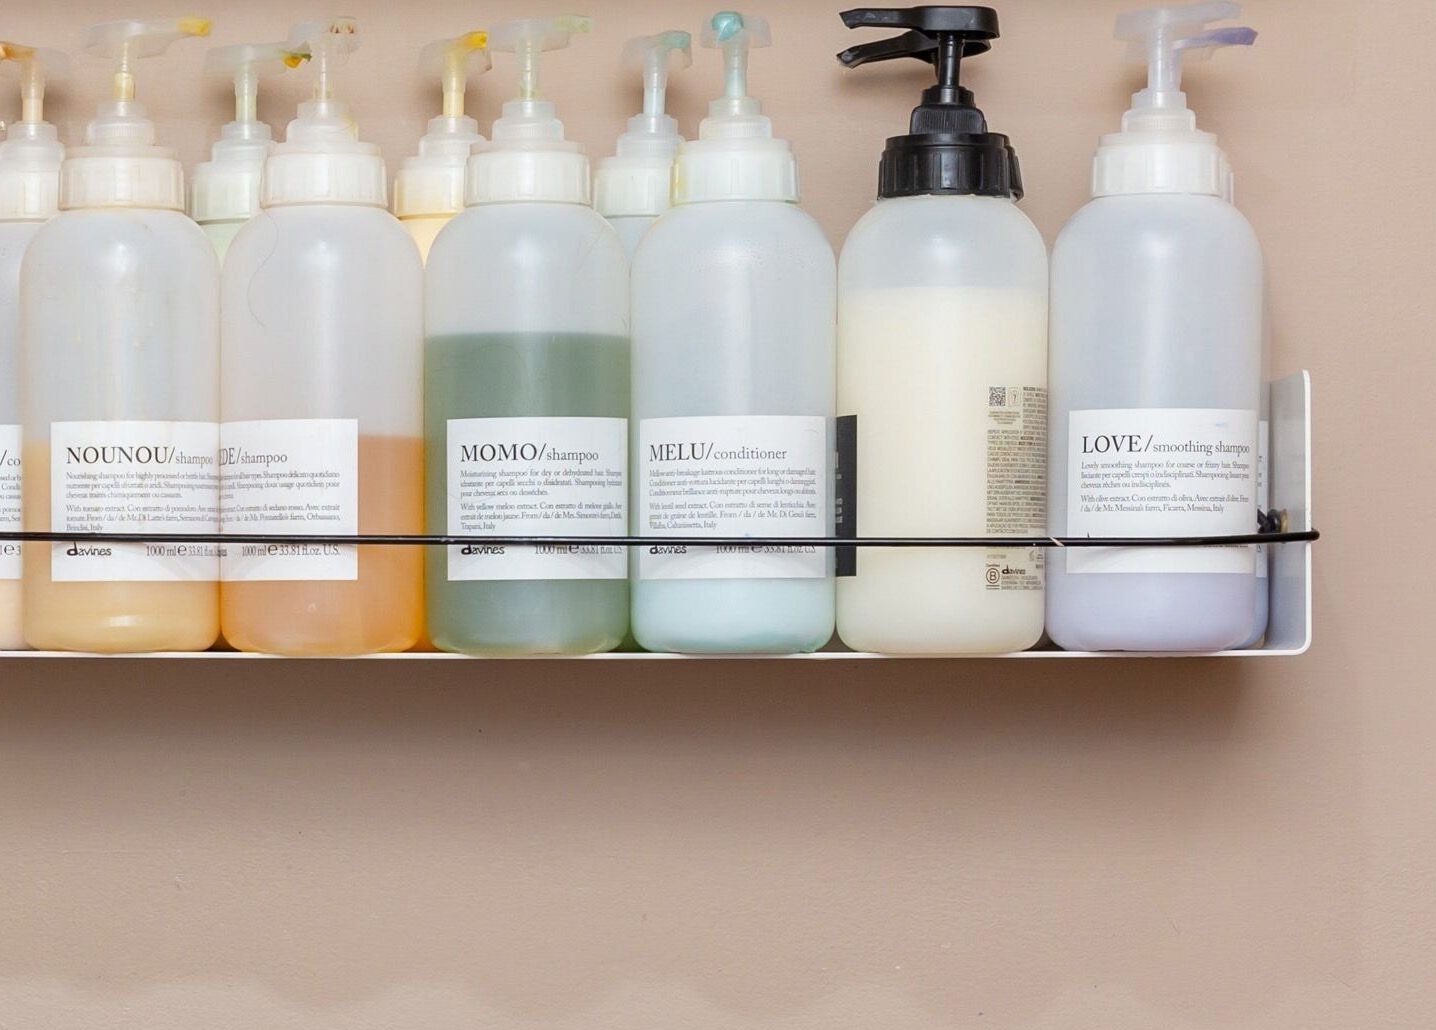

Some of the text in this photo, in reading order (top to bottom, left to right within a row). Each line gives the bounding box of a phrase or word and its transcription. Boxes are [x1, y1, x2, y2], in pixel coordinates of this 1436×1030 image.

[1082, 434, 1250, 457] LOVE/smoothing shampoo
[461, 443, 599, 465] MOMO/shampoo
[649, 442, 788, 462] MELU/conditioner
[1134, 461, 1164, 470] shampoo
[498, 469, 528, 478] shampoo
[66, 541, 112, 556] davines
[146, 545, 165, 556] 1000
[167, 545, 177, 556] ml
[242, 545, 257, 556] 1000
[279, 544, 302, 556] 33.81
[461, 545, 505, 555] davines
[649, 545, 687, 555] davines
